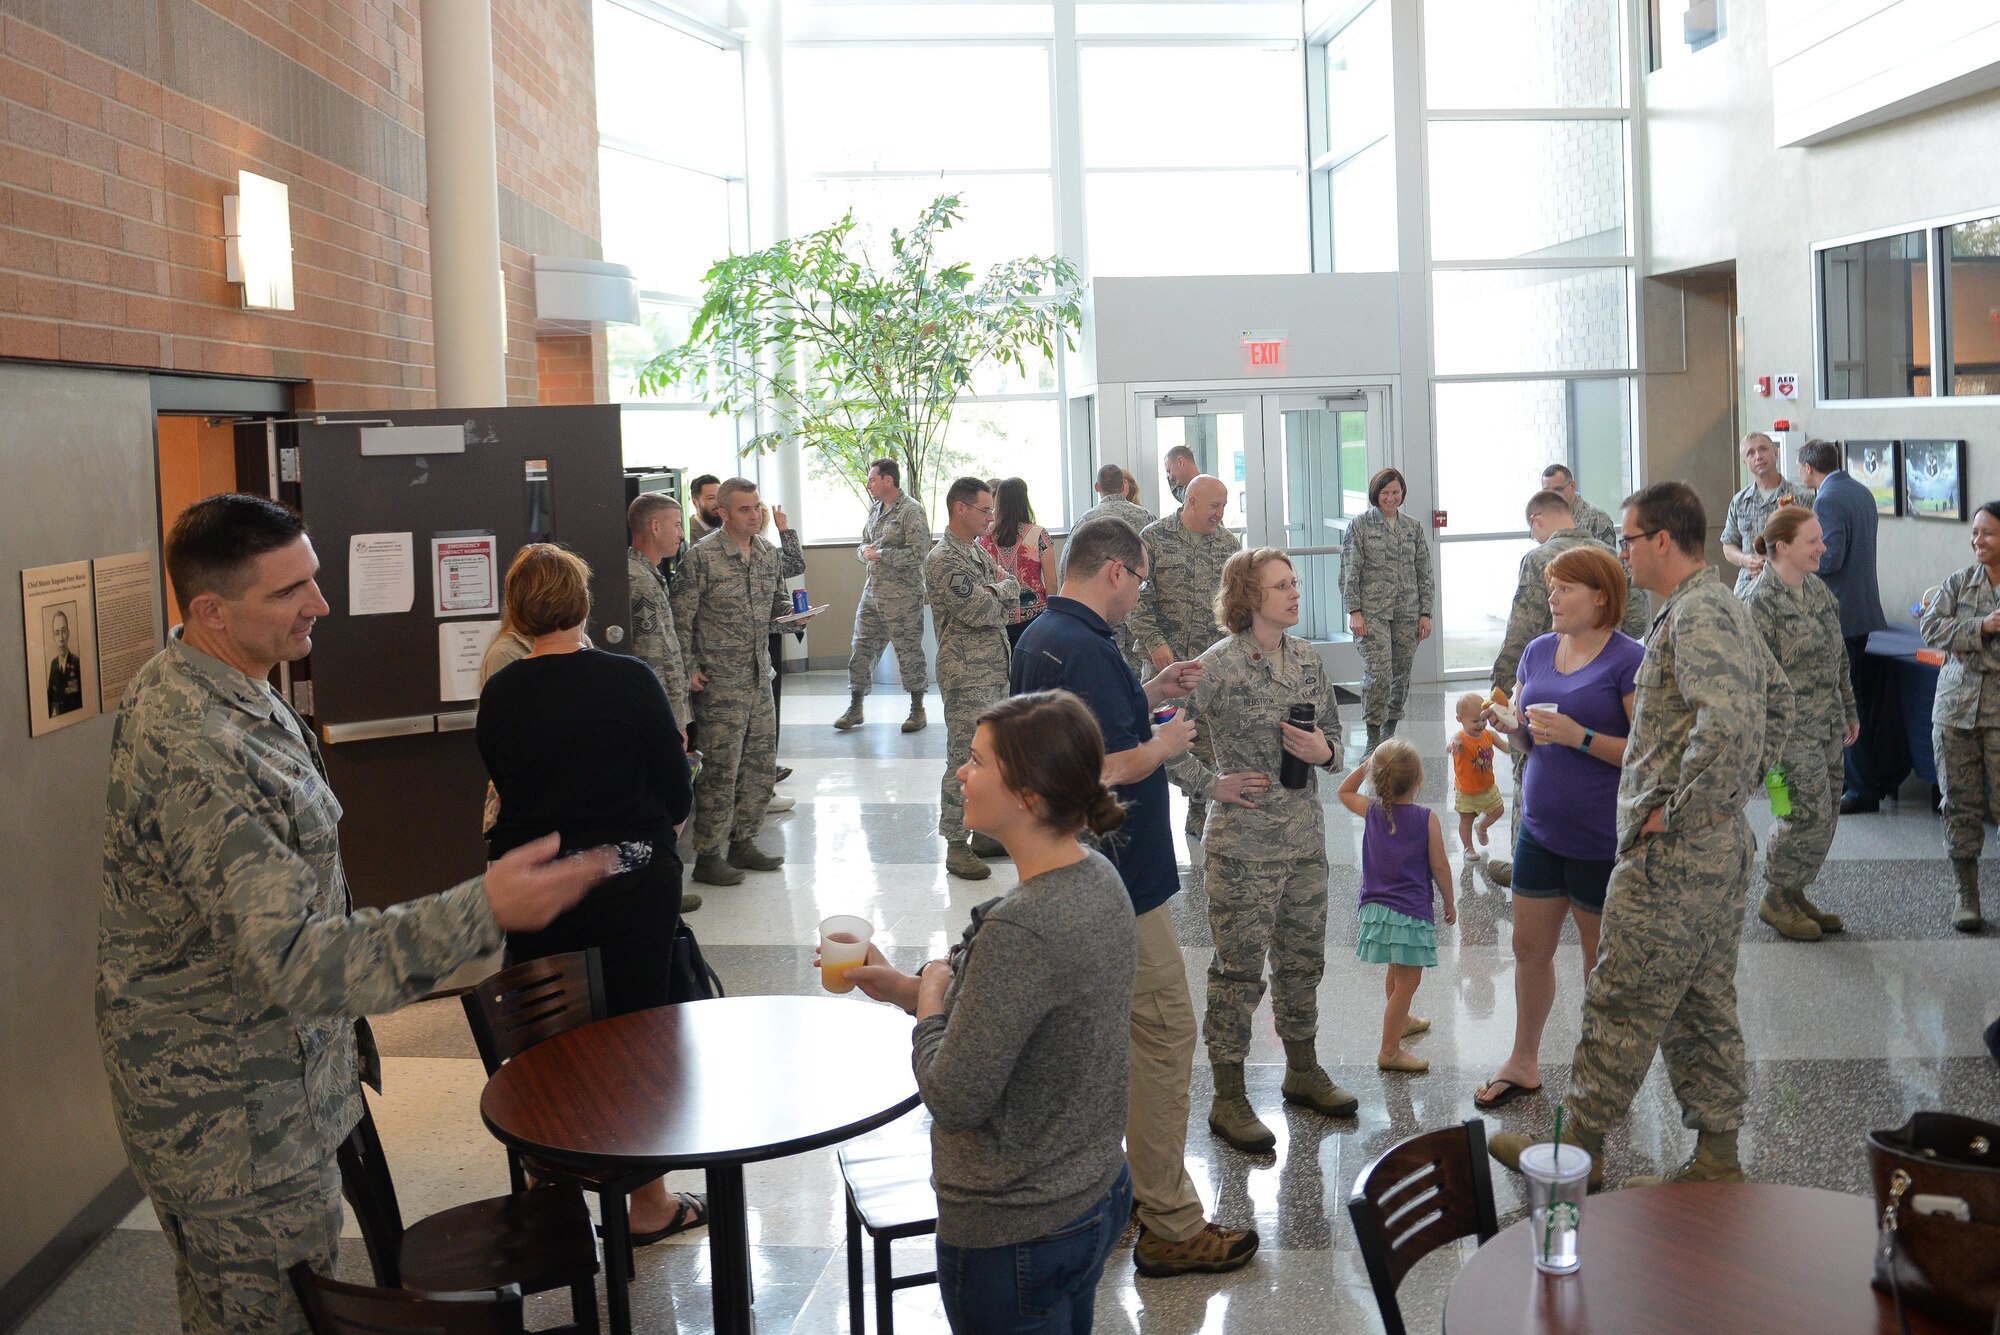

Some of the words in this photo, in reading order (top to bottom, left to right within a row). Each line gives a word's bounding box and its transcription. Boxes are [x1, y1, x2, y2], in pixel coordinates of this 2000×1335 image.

[1250, 343, 1280, 365] EXIT
[28, 581, 38, 589] Chief
[51, 577, 65, 585] Sergeant
[1243, 697, 1275, 706] HEDSTROM
